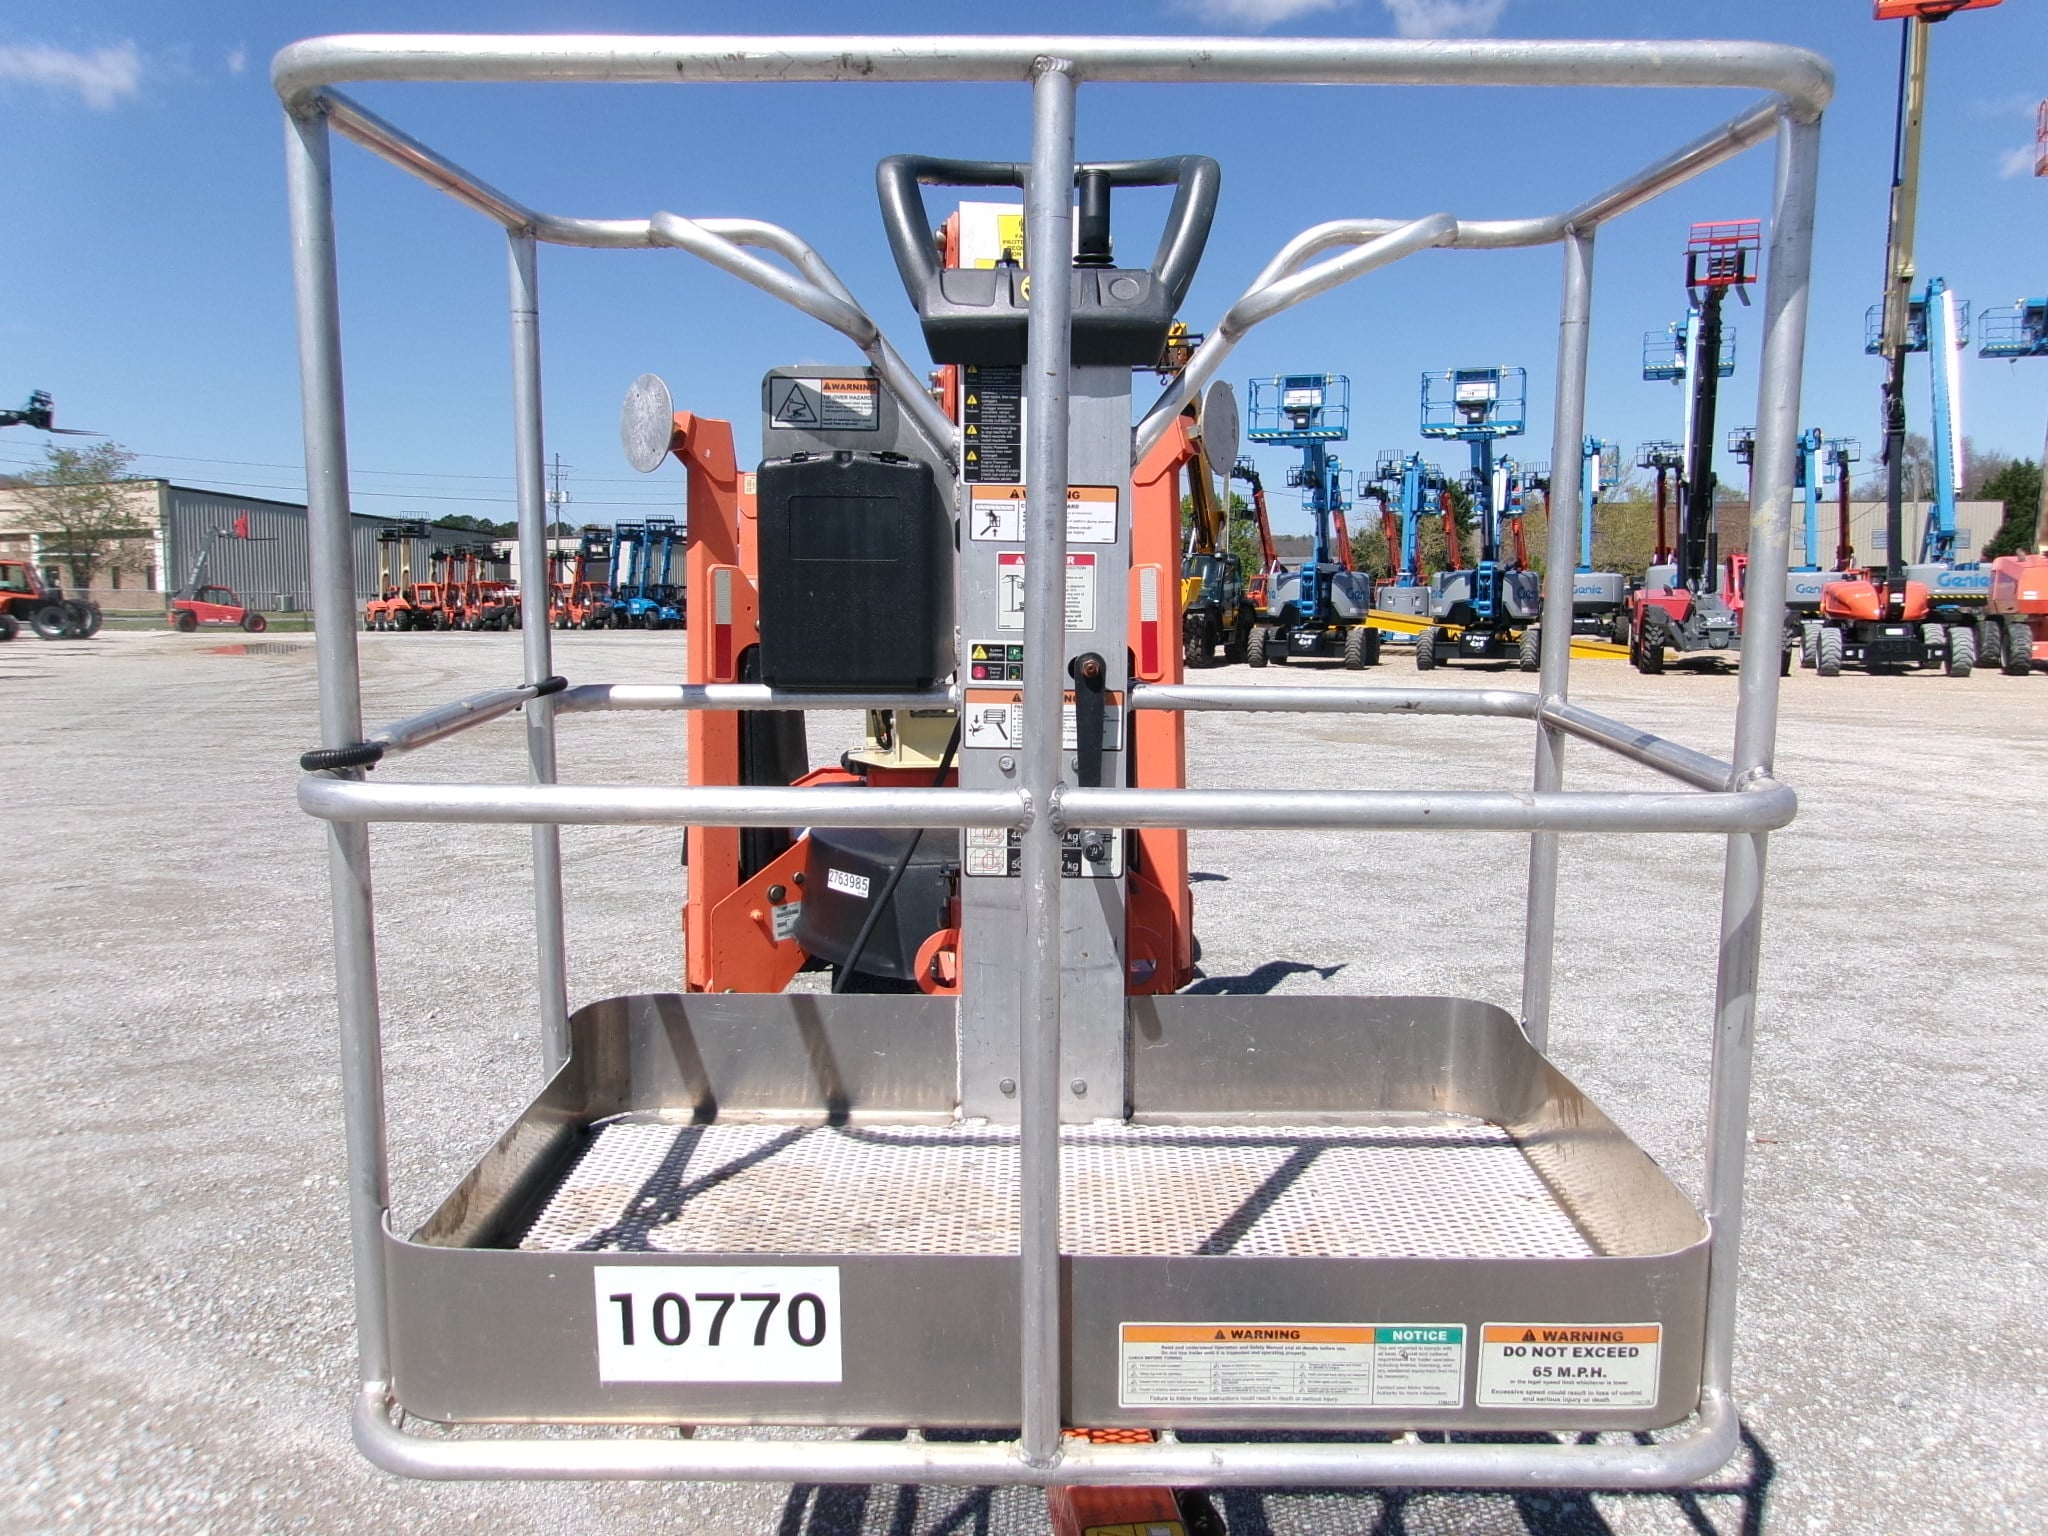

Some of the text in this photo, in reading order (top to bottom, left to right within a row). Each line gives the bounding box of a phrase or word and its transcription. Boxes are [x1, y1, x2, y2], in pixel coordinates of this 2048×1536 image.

[831, 383, 876, 391] WARNING
[1937, 572, 1992, 588] Genie
[1067, 861, 1079, 871] kg
[609, 1292, 827, 1347] 10770
[1230, 1329, 1301, 1341] WARNING
[1392, 1330, 1448, 1341] NOTICE
[1542, 1330, 1624, 1343] WARNING
[1503, 1346, 1640, 1358] DO NOT EXCEED
[1532, 1366, 1607, 1378] 65 M.P.H.
